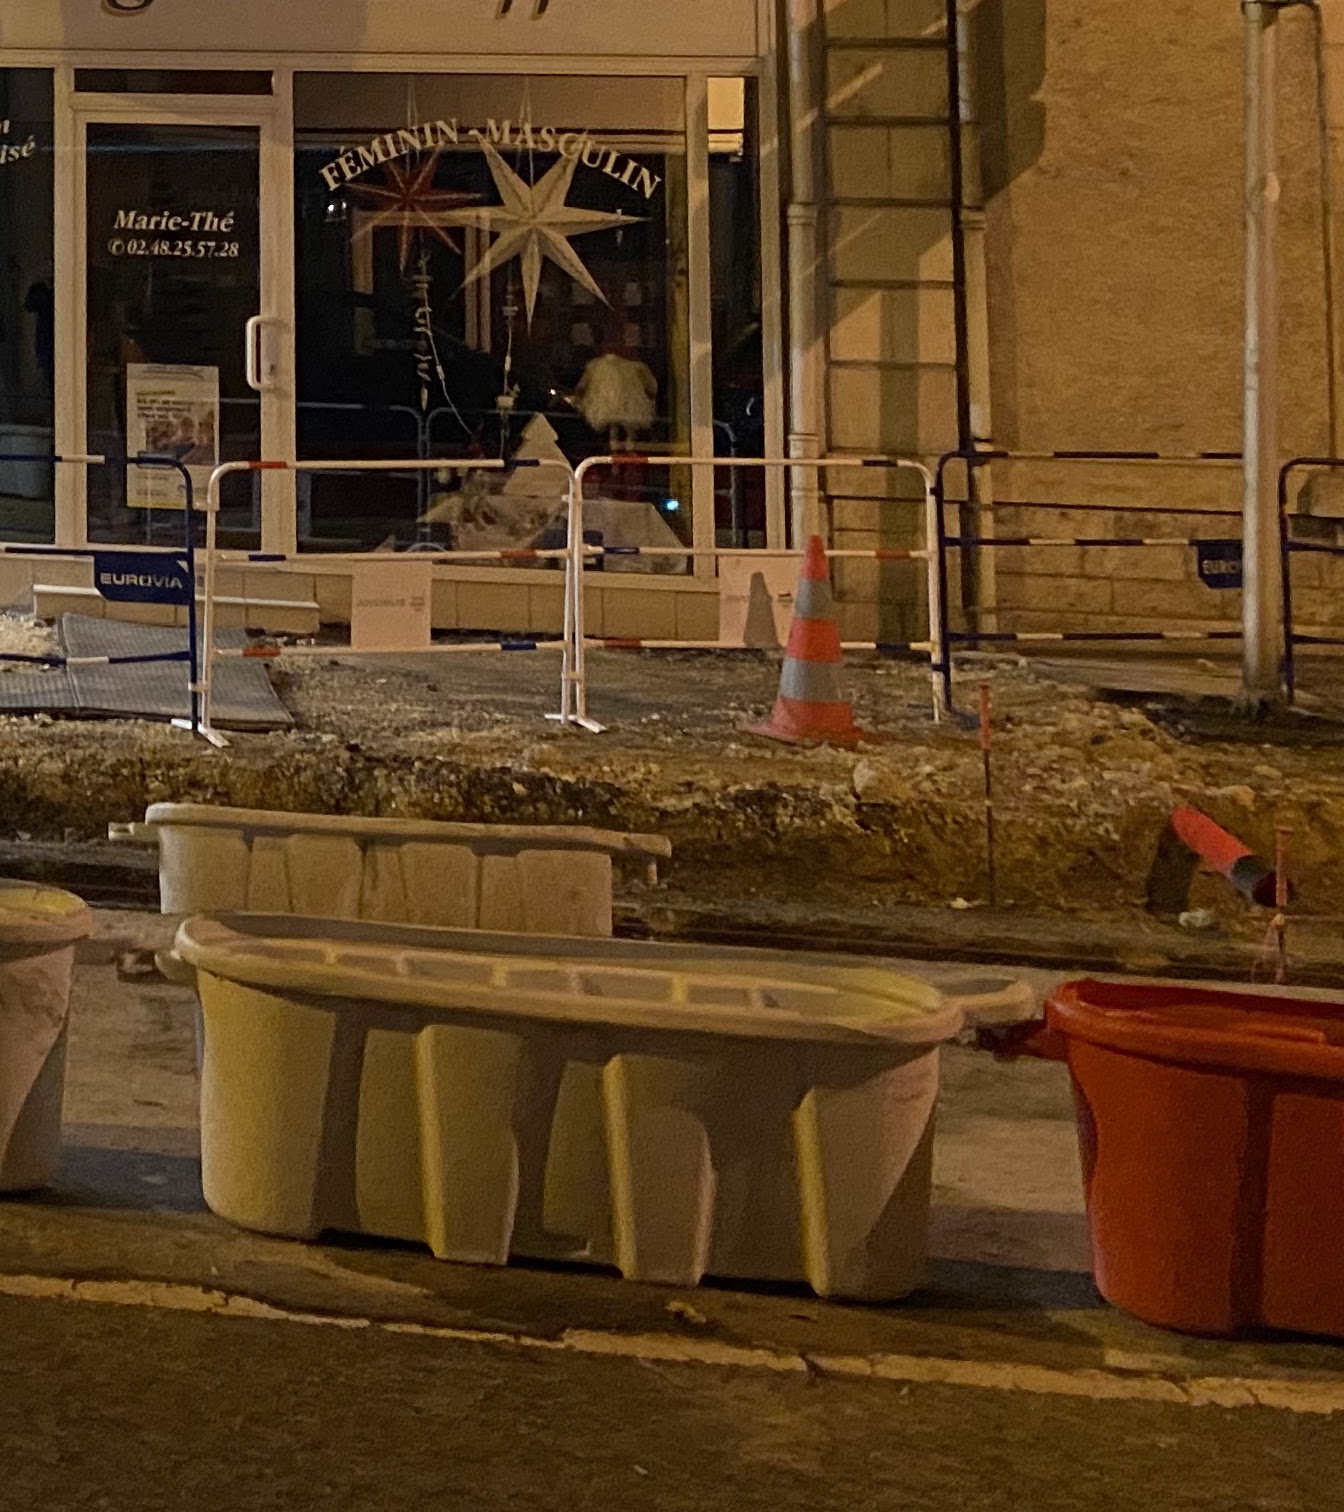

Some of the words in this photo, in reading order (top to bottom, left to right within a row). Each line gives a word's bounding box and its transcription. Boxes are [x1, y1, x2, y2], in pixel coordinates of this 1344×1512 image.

[319, 117, 460, 191] FÉMININ
[484, 118, 662, 200] MASCULIN
[113, 209, 234, 234] Marie-Thé
[126, 239, 239, 258] 02.48.25.57.28
[99, 570, 183, 589] EUROVIA
